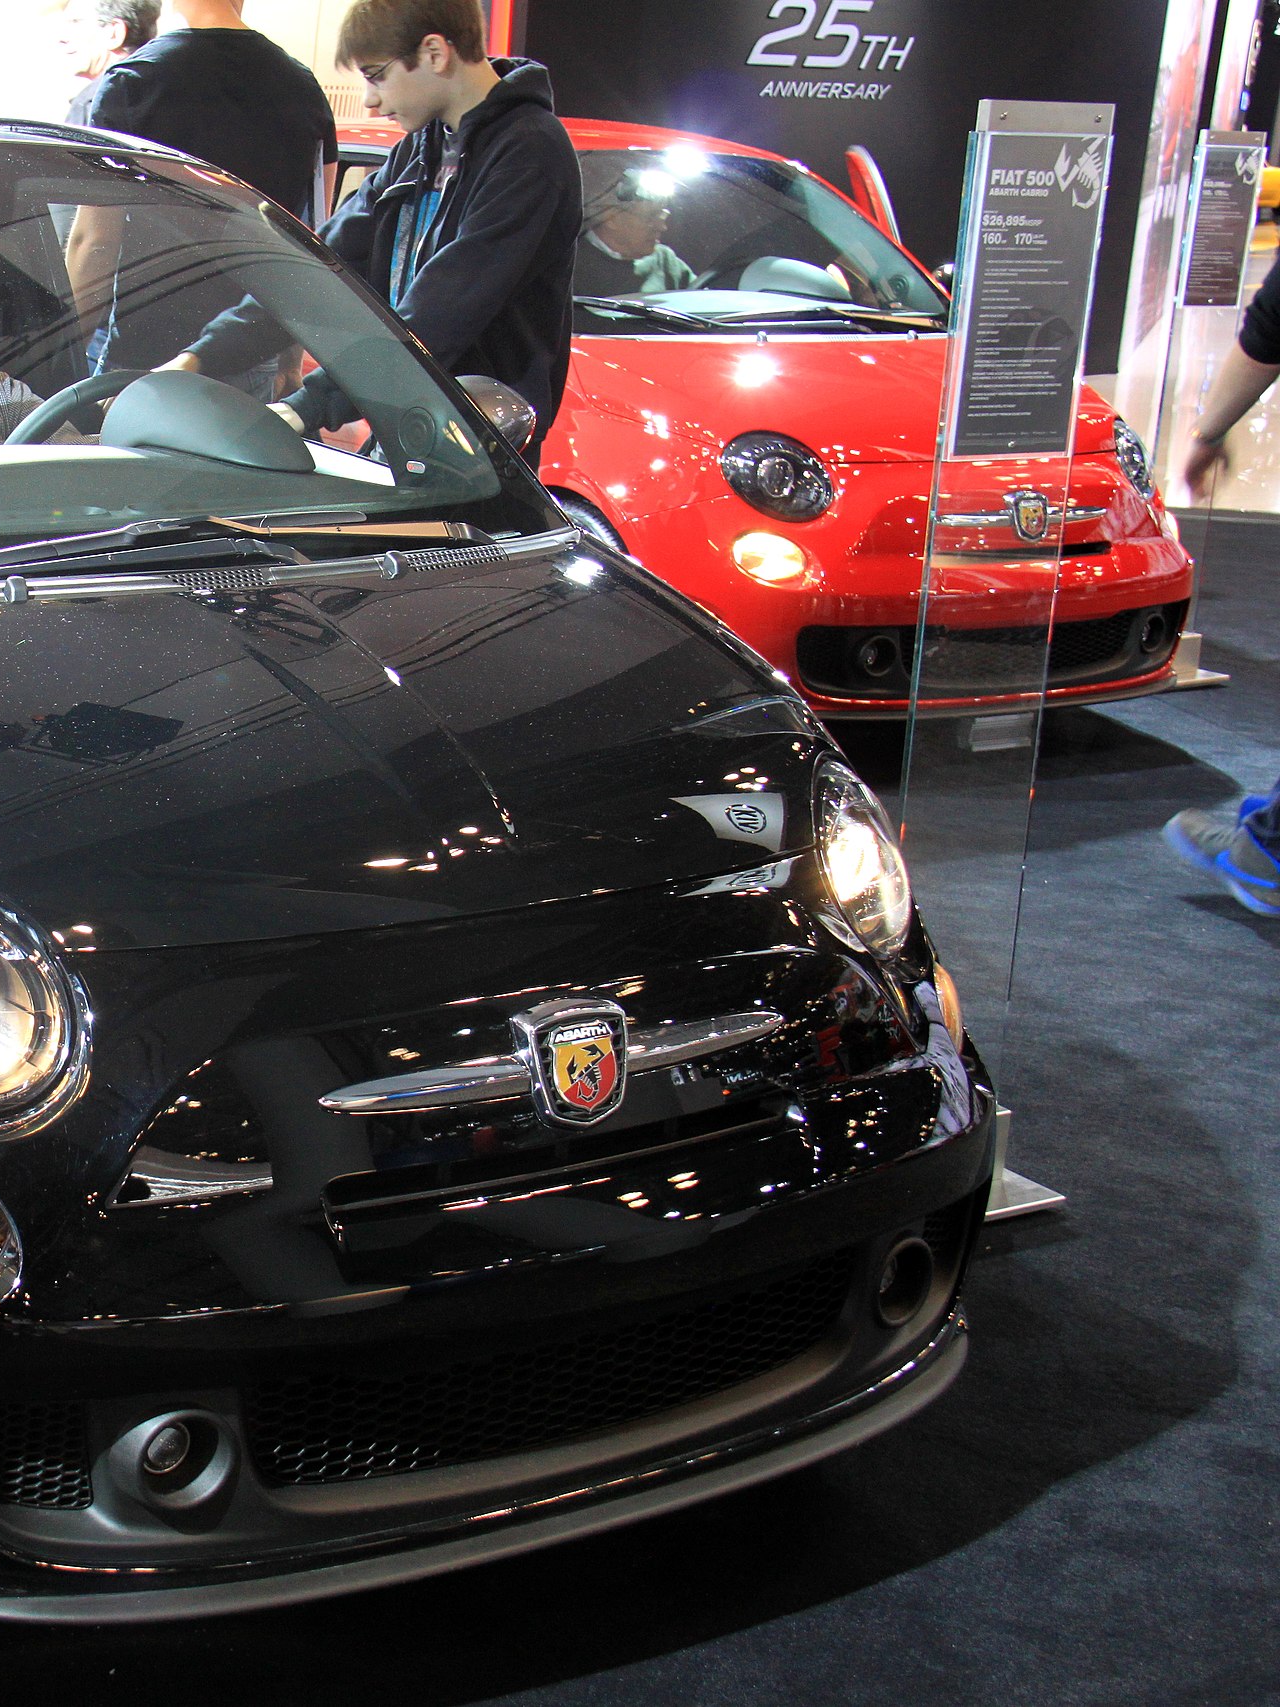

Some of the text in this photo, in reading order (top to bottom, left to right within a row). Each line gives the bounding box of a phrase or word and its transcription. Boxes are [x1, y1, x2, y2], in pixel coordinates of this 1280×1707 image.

[746, 0, 915, 71] 25TH
[759, 80, 891, 100] ANNIVERSARY
[991, 170, 1055, 186] FIAT 500
[989, 188, 1049, 197] ABARTH CABRIO
[982, 214, 1026, 228] $26,895
[982, 232, 1002, 244] 160
[1014, 232, 1033, 245] 170
[555, 1026, 607, 1043] ABARTH
